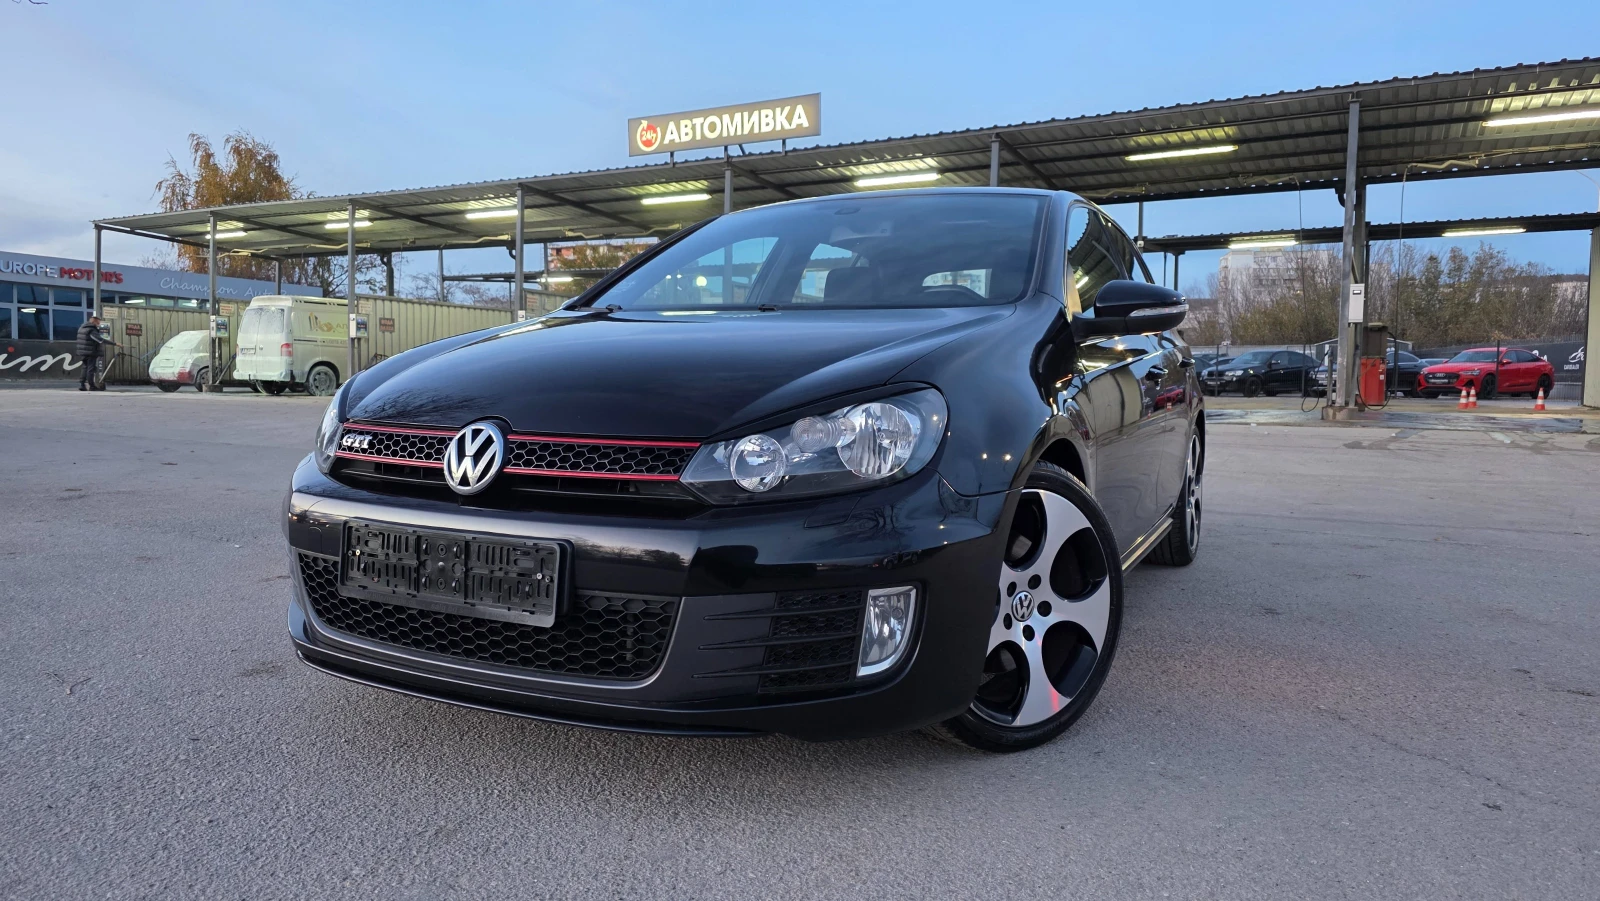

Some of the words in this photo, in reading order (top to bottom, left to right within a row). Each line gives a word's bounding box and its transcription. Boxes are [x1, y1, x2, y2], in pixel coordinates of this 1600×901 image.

[663, 104, 809, 145] АВТОМИВКА
[160, 277, 238, 297] Champon
[342, 433, 373, 449] GTI
